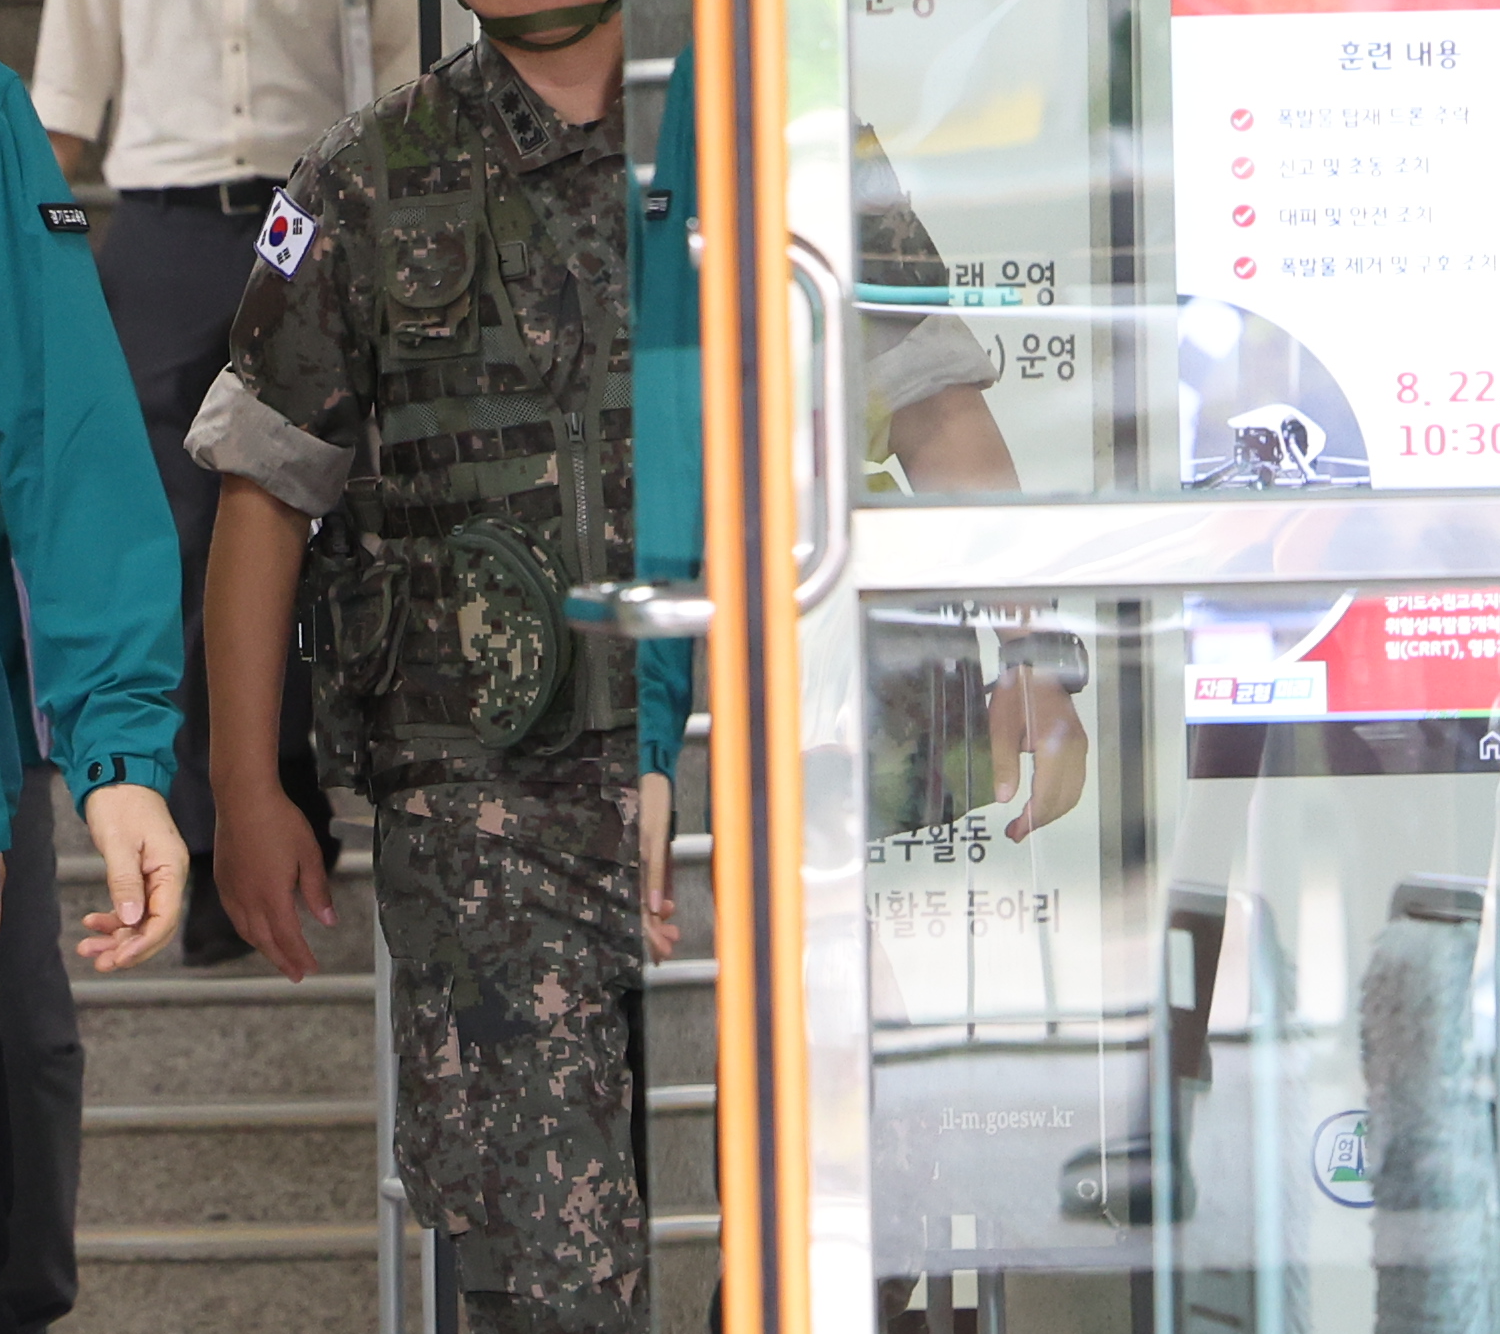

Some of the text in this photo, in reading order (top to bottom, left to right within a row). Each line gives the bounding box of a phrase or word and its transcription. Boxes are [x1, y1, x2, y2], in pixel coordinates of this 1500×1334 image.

[1337, 39, 1463, 72] 훈련 내용
[1279, 205, 1432, 228] 대피 및 안전 조치
[1281, 256, 1337, 278] 폭발물
[1344, 255, 1382, 275] 제거
[949, 260, 1056, 307] 램 운영
[1016, 333, 1076, 381] 운영
[963, 887, 1061, 939] 동아리
[938, 1105, 1075, 1136] il-m.goesw.kr
